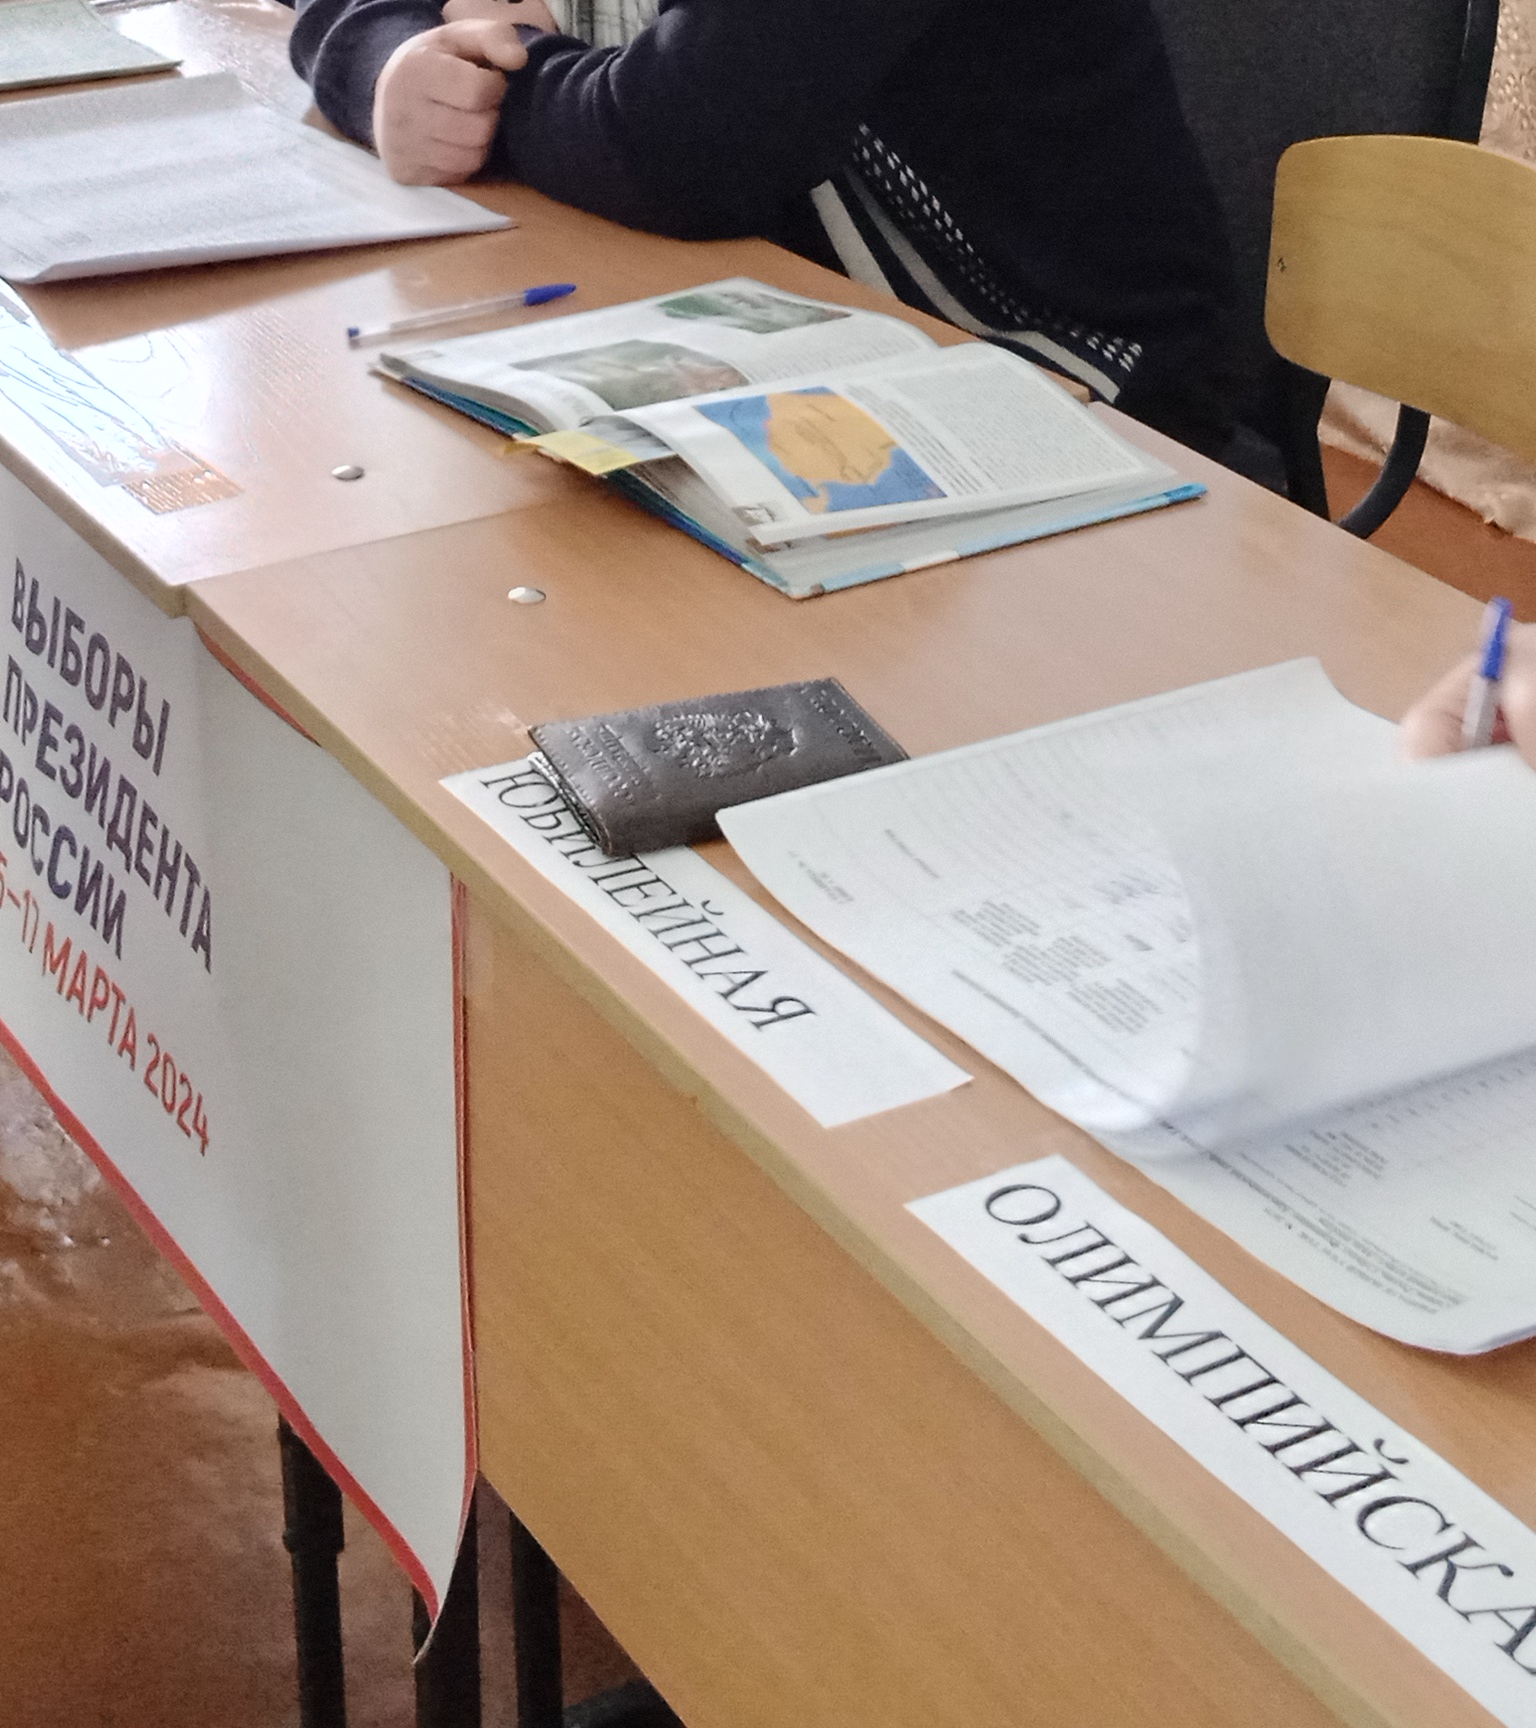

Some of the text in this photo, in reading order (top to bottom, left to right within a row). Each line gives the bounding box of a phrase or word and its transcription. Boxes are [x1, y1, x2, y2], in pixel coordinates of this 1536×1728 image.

[11, 556, 170, 776] ВЫБОРЫ
[3, 654, 211, 973] ПРЕЗИДЕНТА
[42, 922, 137, 1071] МАРТА
[144, 1032, 209, 1156] 2024
